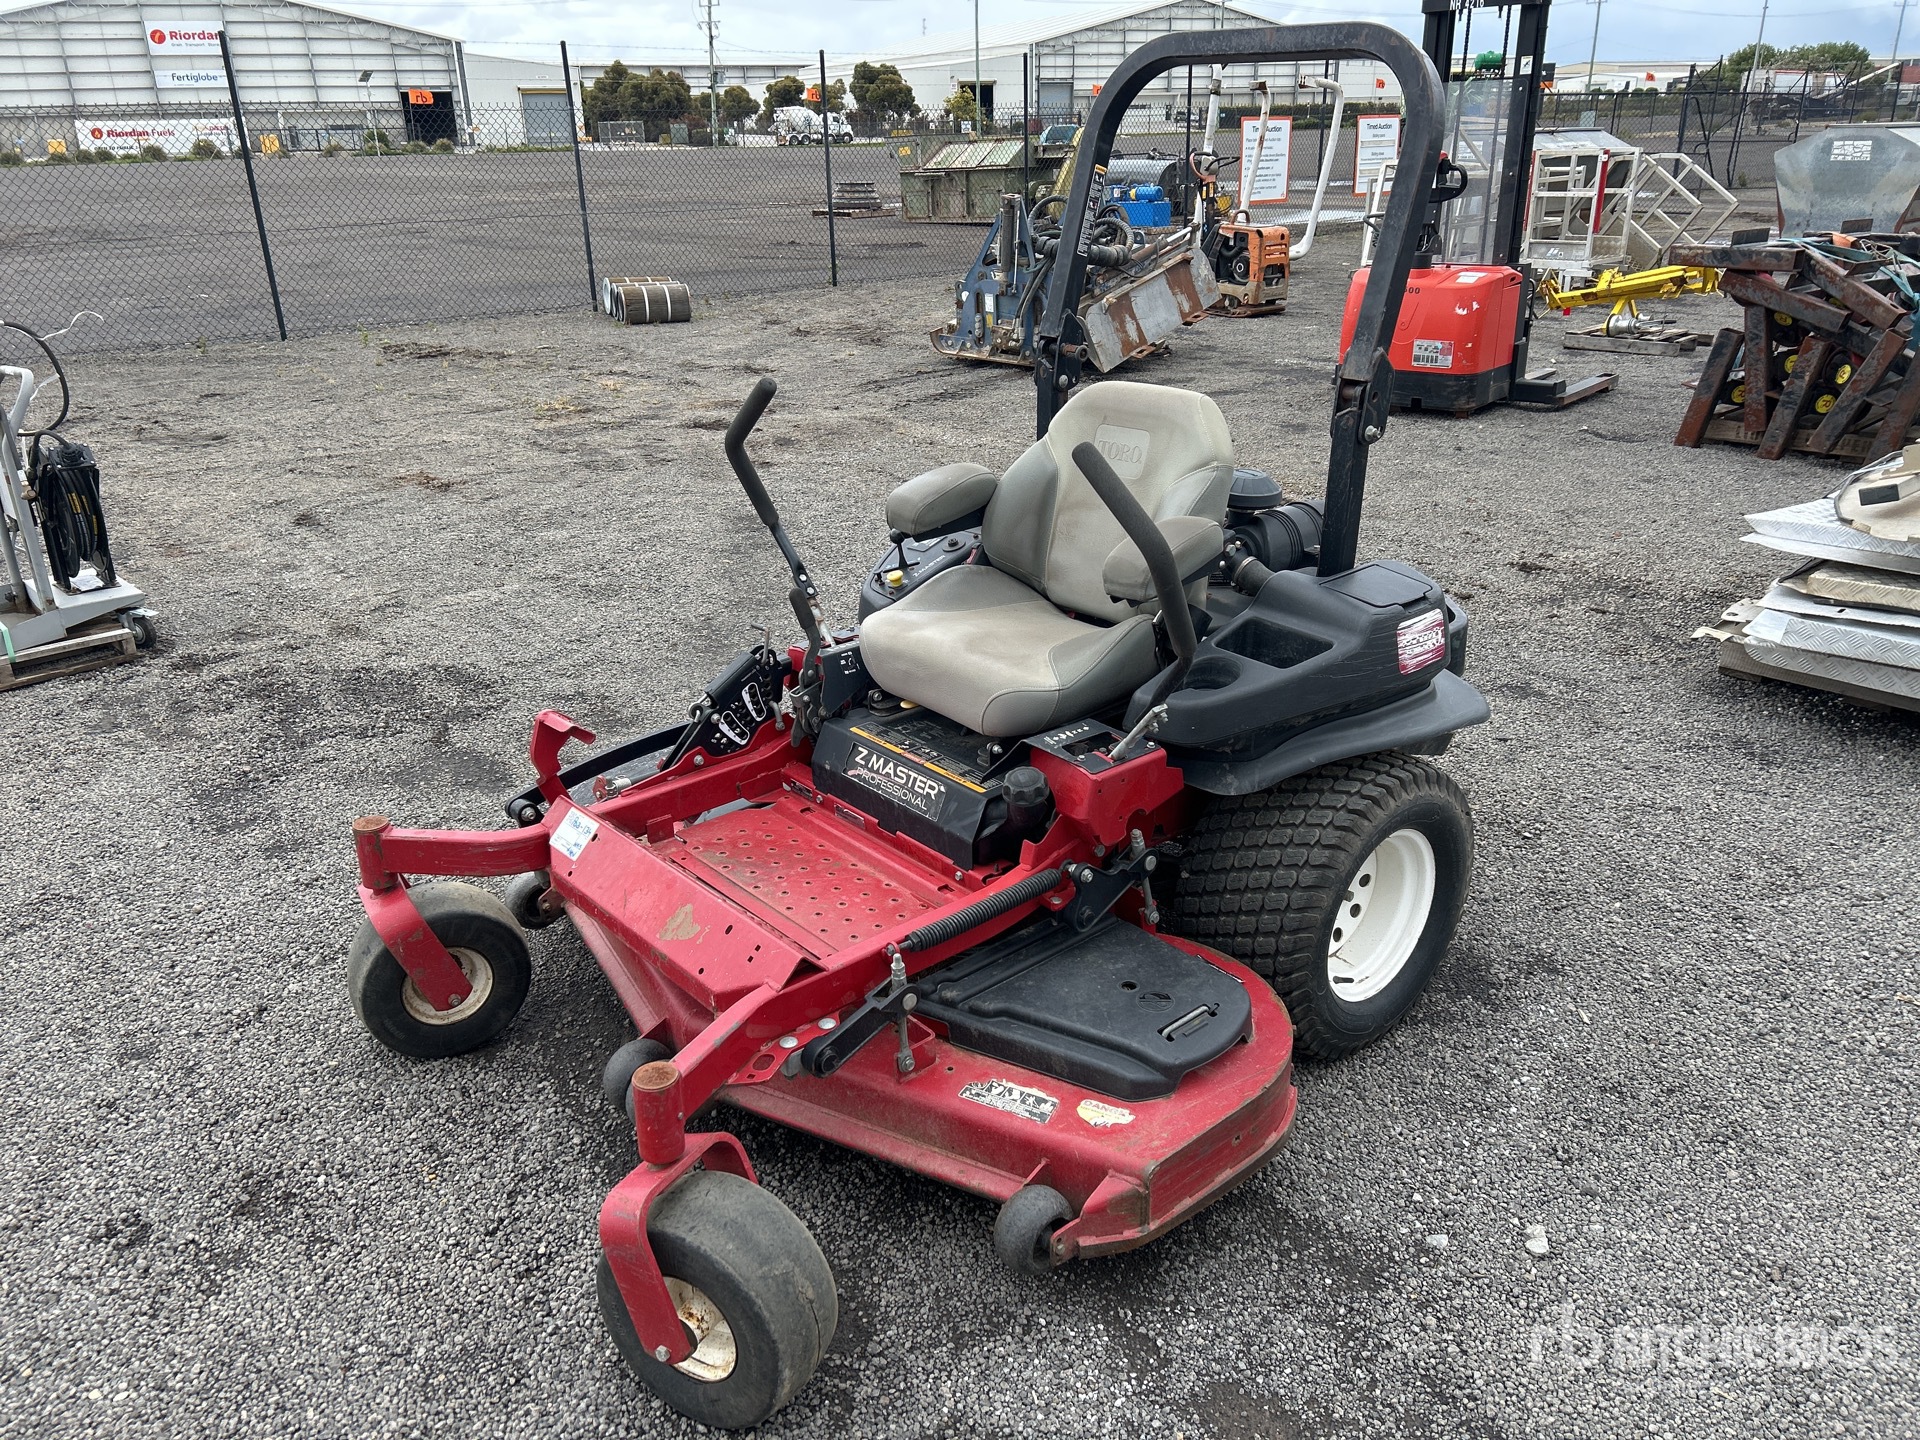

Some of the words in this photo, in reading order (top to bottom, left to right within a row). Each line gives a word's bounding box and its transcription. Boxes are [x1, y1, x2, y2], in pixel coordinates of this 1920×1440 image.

[171, 73, 218, 83] Fertiglobe
[106, 128, 149, 138] Riordan
[151, 128, 176, 138] Fuels
[1266, 125, 1283, 133] Auction
[1098, 440, 1143, 463] TORO
[854, 746, 869, 765] Z
[868, 753, 939, 800] MASTER
[856, 766, 928, 811] PROFESSIONAL
[1083, 1100, 1127, 1117] DANG
